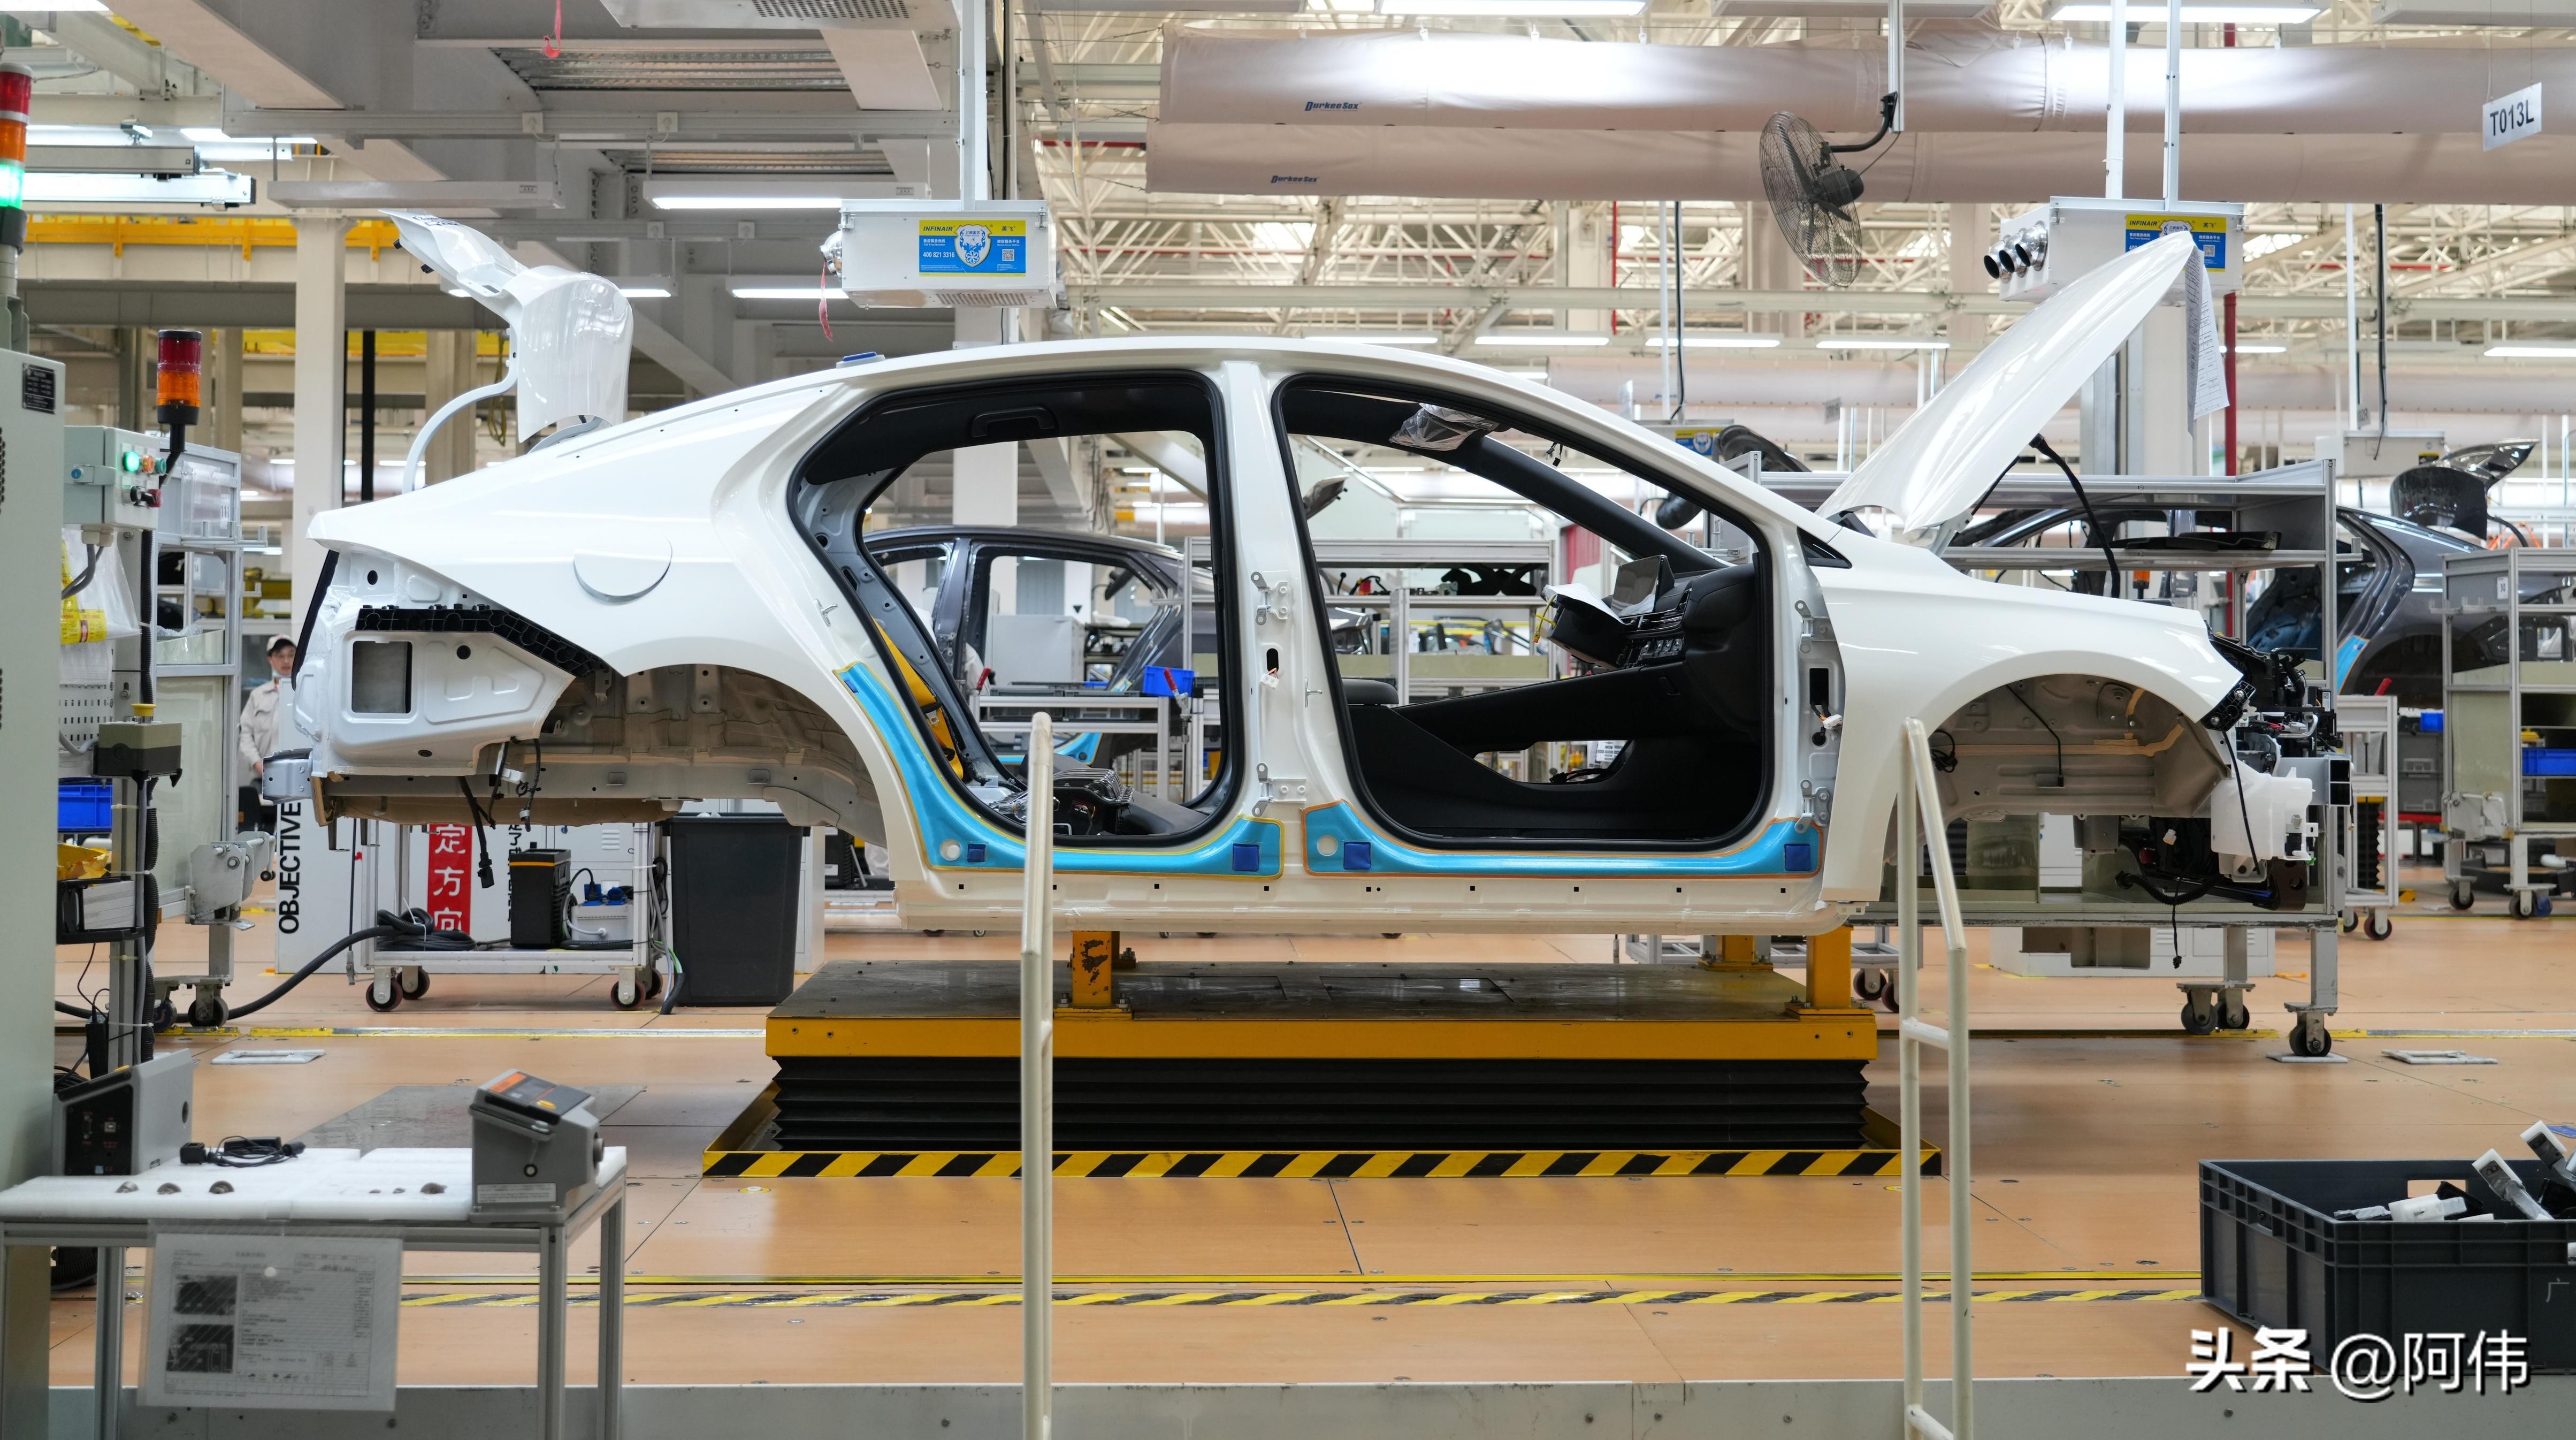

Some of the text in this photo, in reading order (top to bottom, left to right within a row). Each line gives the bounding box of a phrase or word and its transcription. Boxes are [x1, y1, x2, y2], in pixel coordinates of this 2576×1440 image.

[2489, 100, 2534, 136] T013L
[279, 803, 301, 934] OBJECTIVE
[433, 824, 466, 931] 定方向
